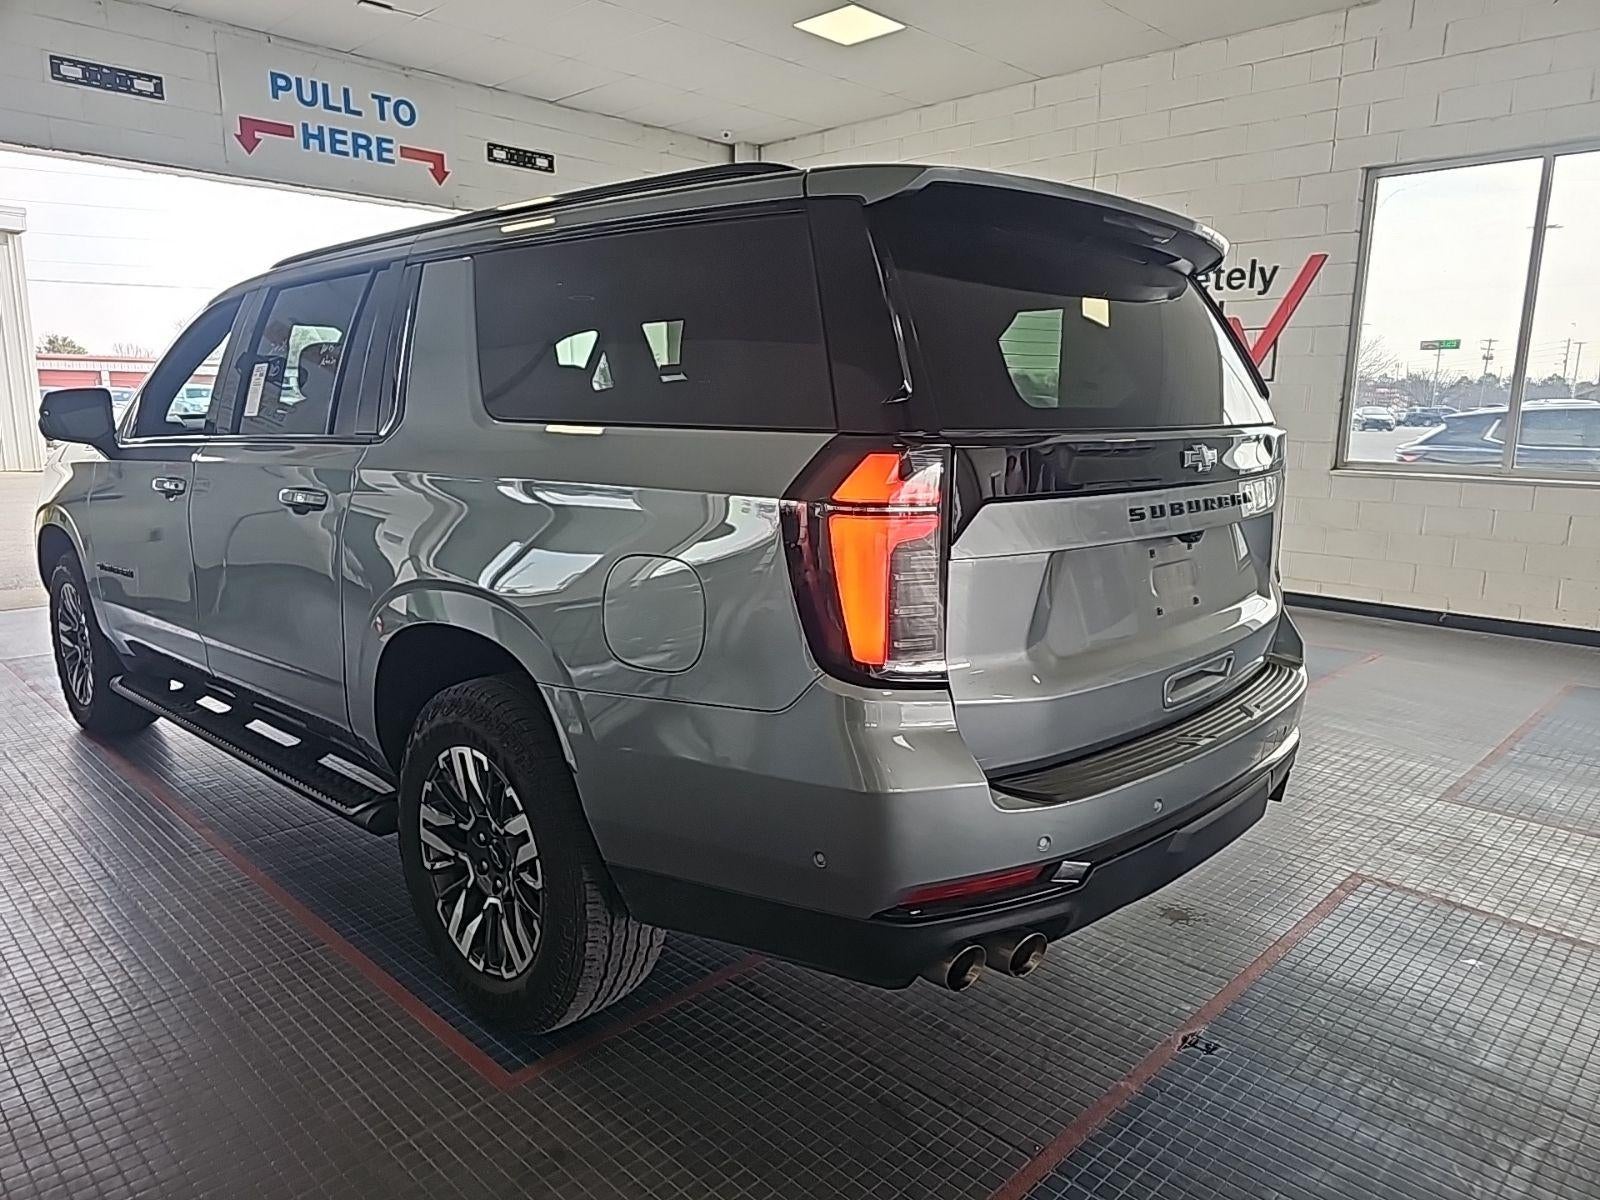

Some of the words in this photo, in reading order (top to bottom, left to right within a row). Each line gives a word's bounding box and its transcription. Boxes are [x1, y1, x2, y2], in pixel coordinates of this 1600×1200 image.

[269, 70, 363, 117] PULL
[371, 93, 417, 127] TO
[301, 122, 396, 165] HERE
